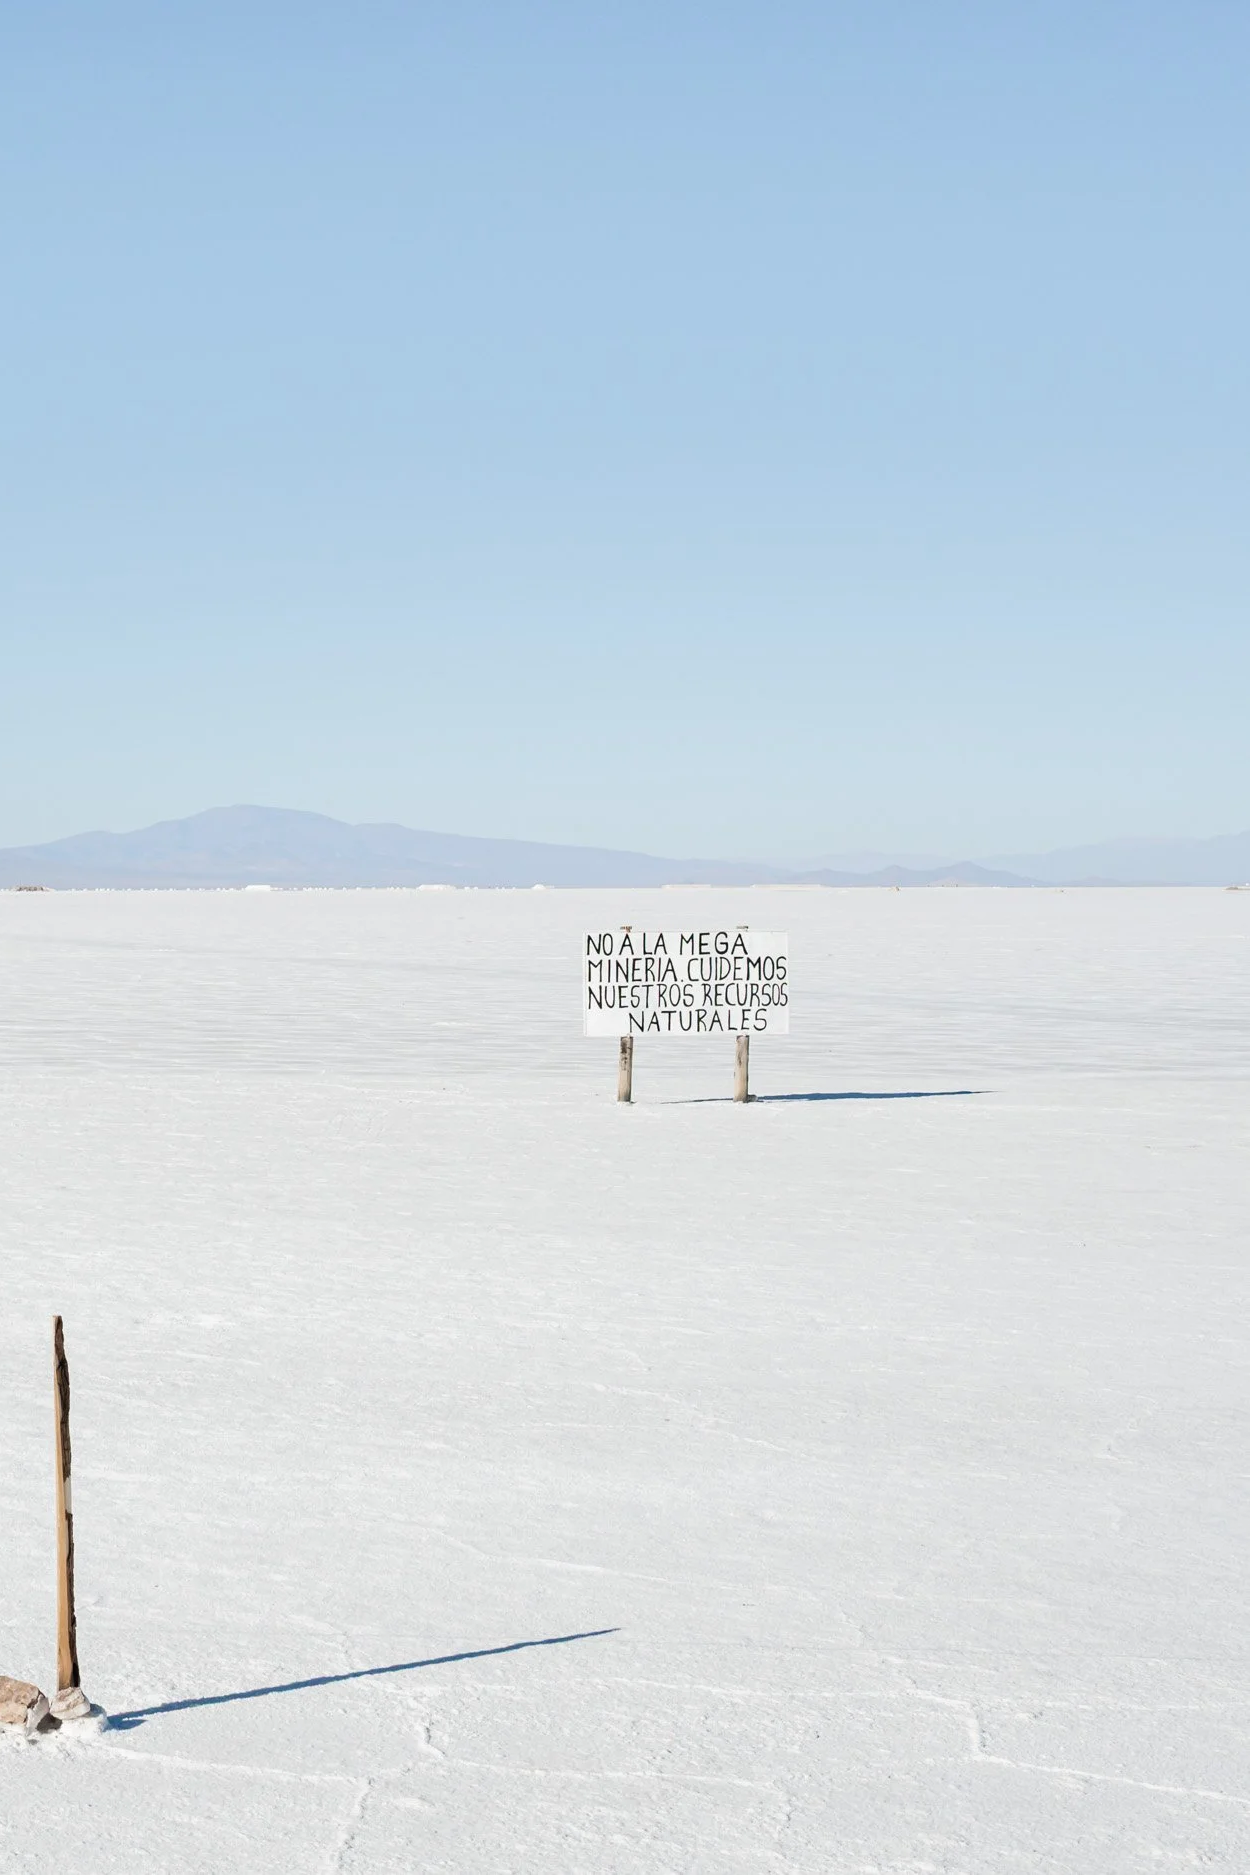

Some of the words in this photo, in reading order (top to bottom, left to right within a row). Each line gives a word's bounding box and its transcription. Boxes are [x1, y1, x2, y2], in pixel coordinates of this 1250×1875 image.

[586, 933, 614, 956] NO
[618, 933, 634, 956] A
[642, 932, 668, 956] LA
[679, 931, 749, 956] MEGA
[588, 957, 684, 983] MINERIA.
[687, 956, 787, 982] CUIDEMOS
[588, 984, 695, 1010] NUESTROS
[701, 982, 788, 1007] RECURSOS
[628, 1008, 768, 1033] NATURALES
